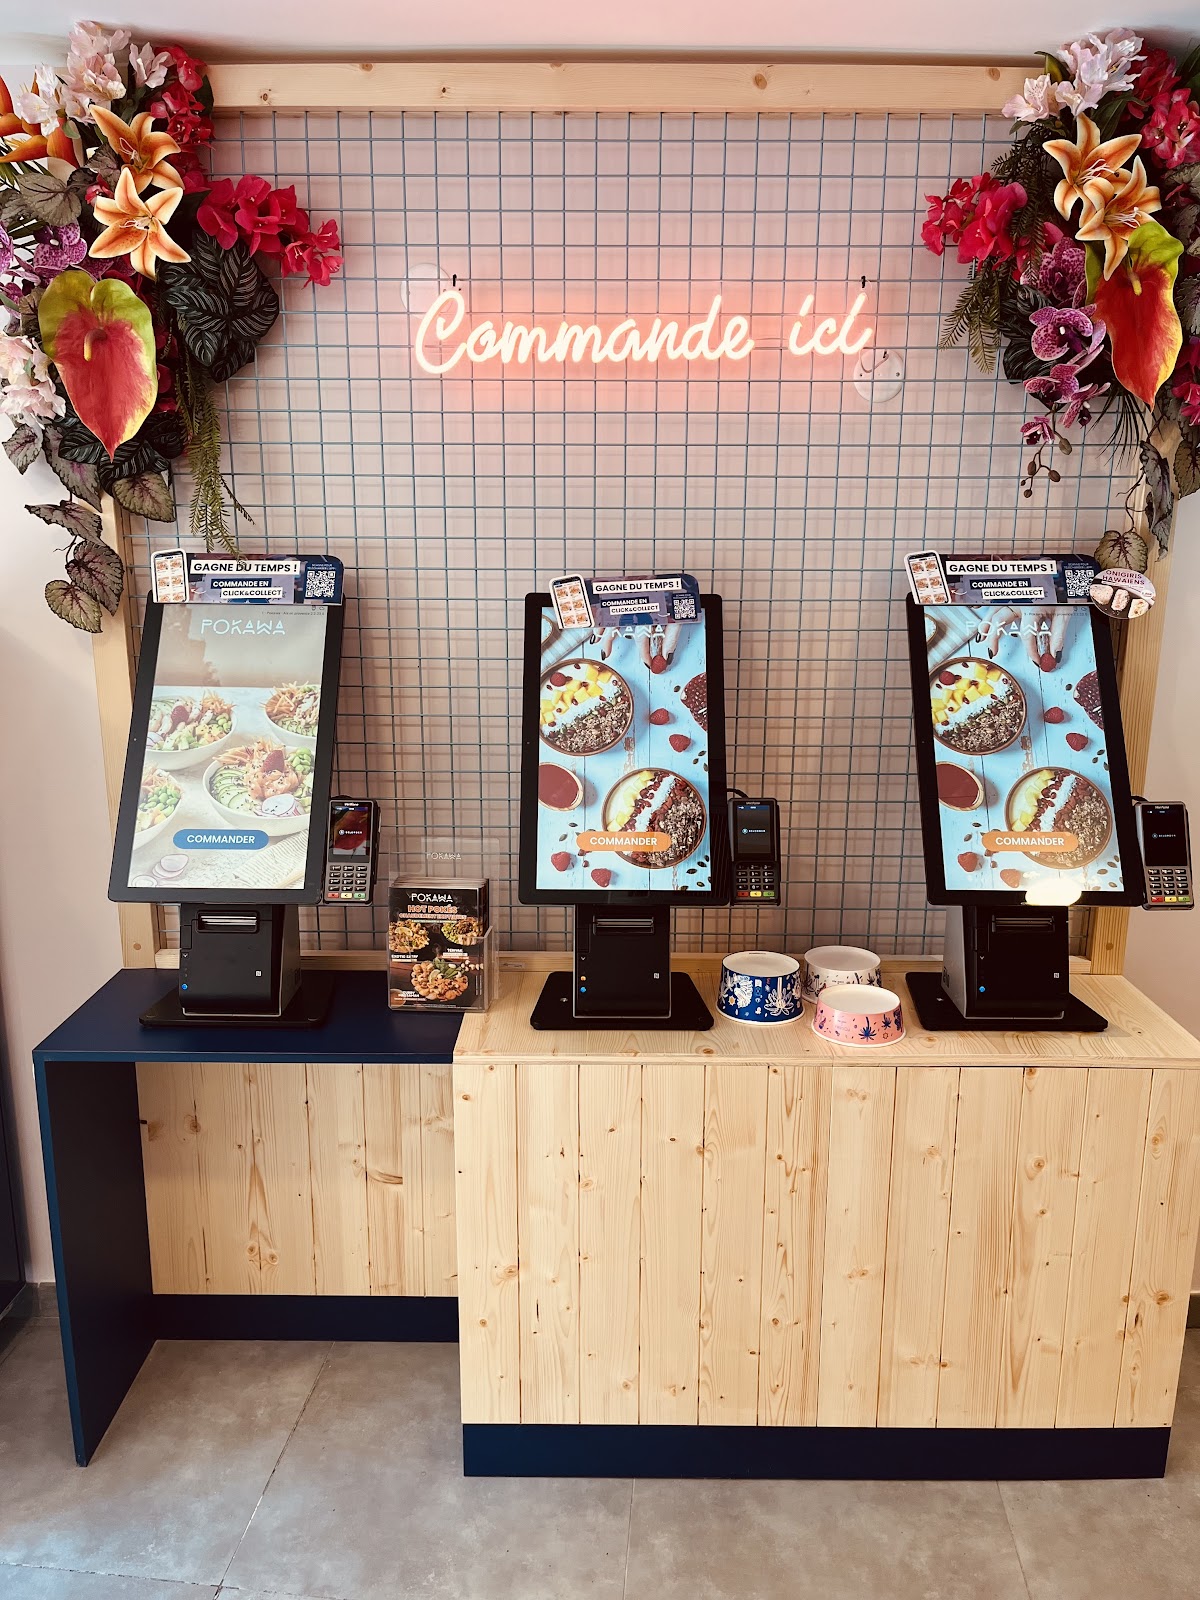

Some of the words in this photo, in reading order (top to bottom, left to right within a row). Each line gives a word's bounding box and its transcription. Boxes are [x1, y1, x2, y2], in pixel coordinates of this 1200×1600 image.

[415, 290, 755, 375] Commande
[788, 292, 873, 356] ici
[193, 563, 234, 572] GAGNE
[235, 563, 252, 572] DU
[254, 563, 291, 573] TEMPS
[949, 563, 990, 573] GAGNE
[991, 563, 1007, 573] DU
[1009, 563, 1048, 573] TEMPS
[1105, 569, 1143, 579] ONIGIRIS
[212, 580, 258, 588] COMMANDE
[259, 580, 269, 588] EN
[595, 583, 628, 592] GAGNE
[629, 582, 642, 590] DU
[643, 581, 674, 590] TEMPS
[971, 580, 1017, 588] COMMANDE
[1018, 580, 1029, 588] EN
[222, 589, 282, 597] CLICK&COLLECT
[983, 589, 1043, 598] CLICK&COLLECT
[611, 605, 659, 614] CLICK&COLLECT
[200, 619, 286, 635] POKAWA
[965, 621, 1053, 636] POKAWA
[186, 834, 256, 844] COMMANDER
[589, 836, 658, 846] COMMANDER
[995, 836, 1065, 846] COMMANDER
[411, 892, 453, 903] POKAWA
[407, 904, 428, 913] HOT
[428, 903, 458, 914] POKÉS
